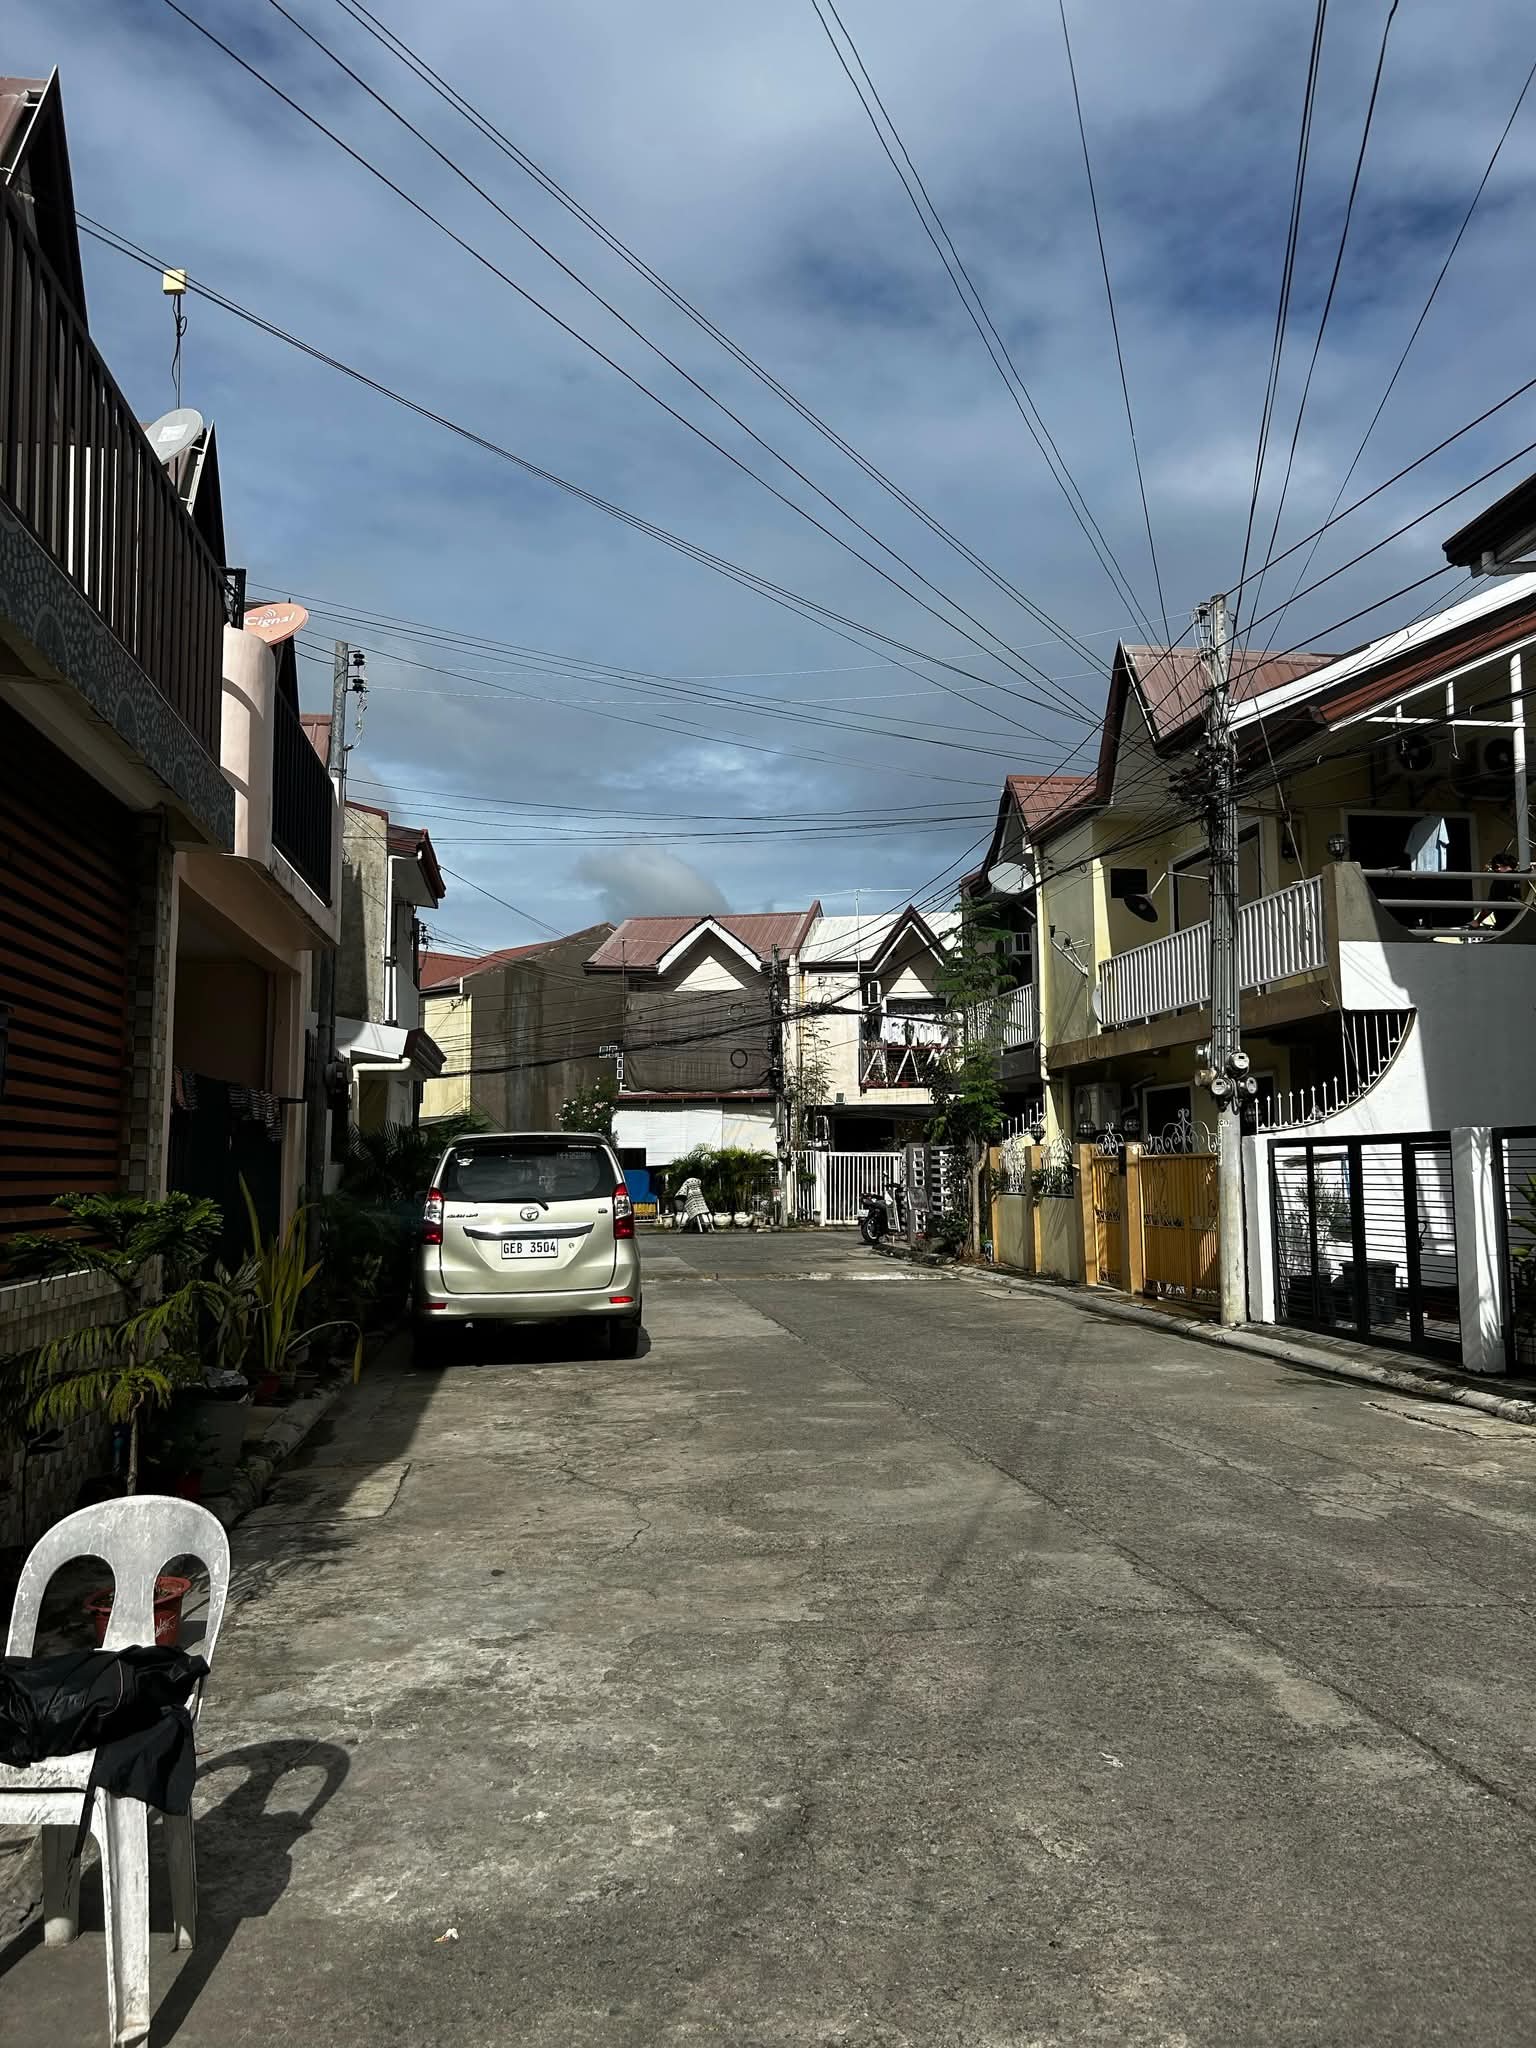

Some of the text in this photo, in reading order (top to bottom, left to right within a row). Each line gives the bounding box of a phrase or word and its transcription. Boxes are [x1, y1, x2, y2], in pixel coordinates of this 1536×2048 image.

[245, 611, 296, 628] Cignal
[503, 1241, 556, 1254] GEB 3504
